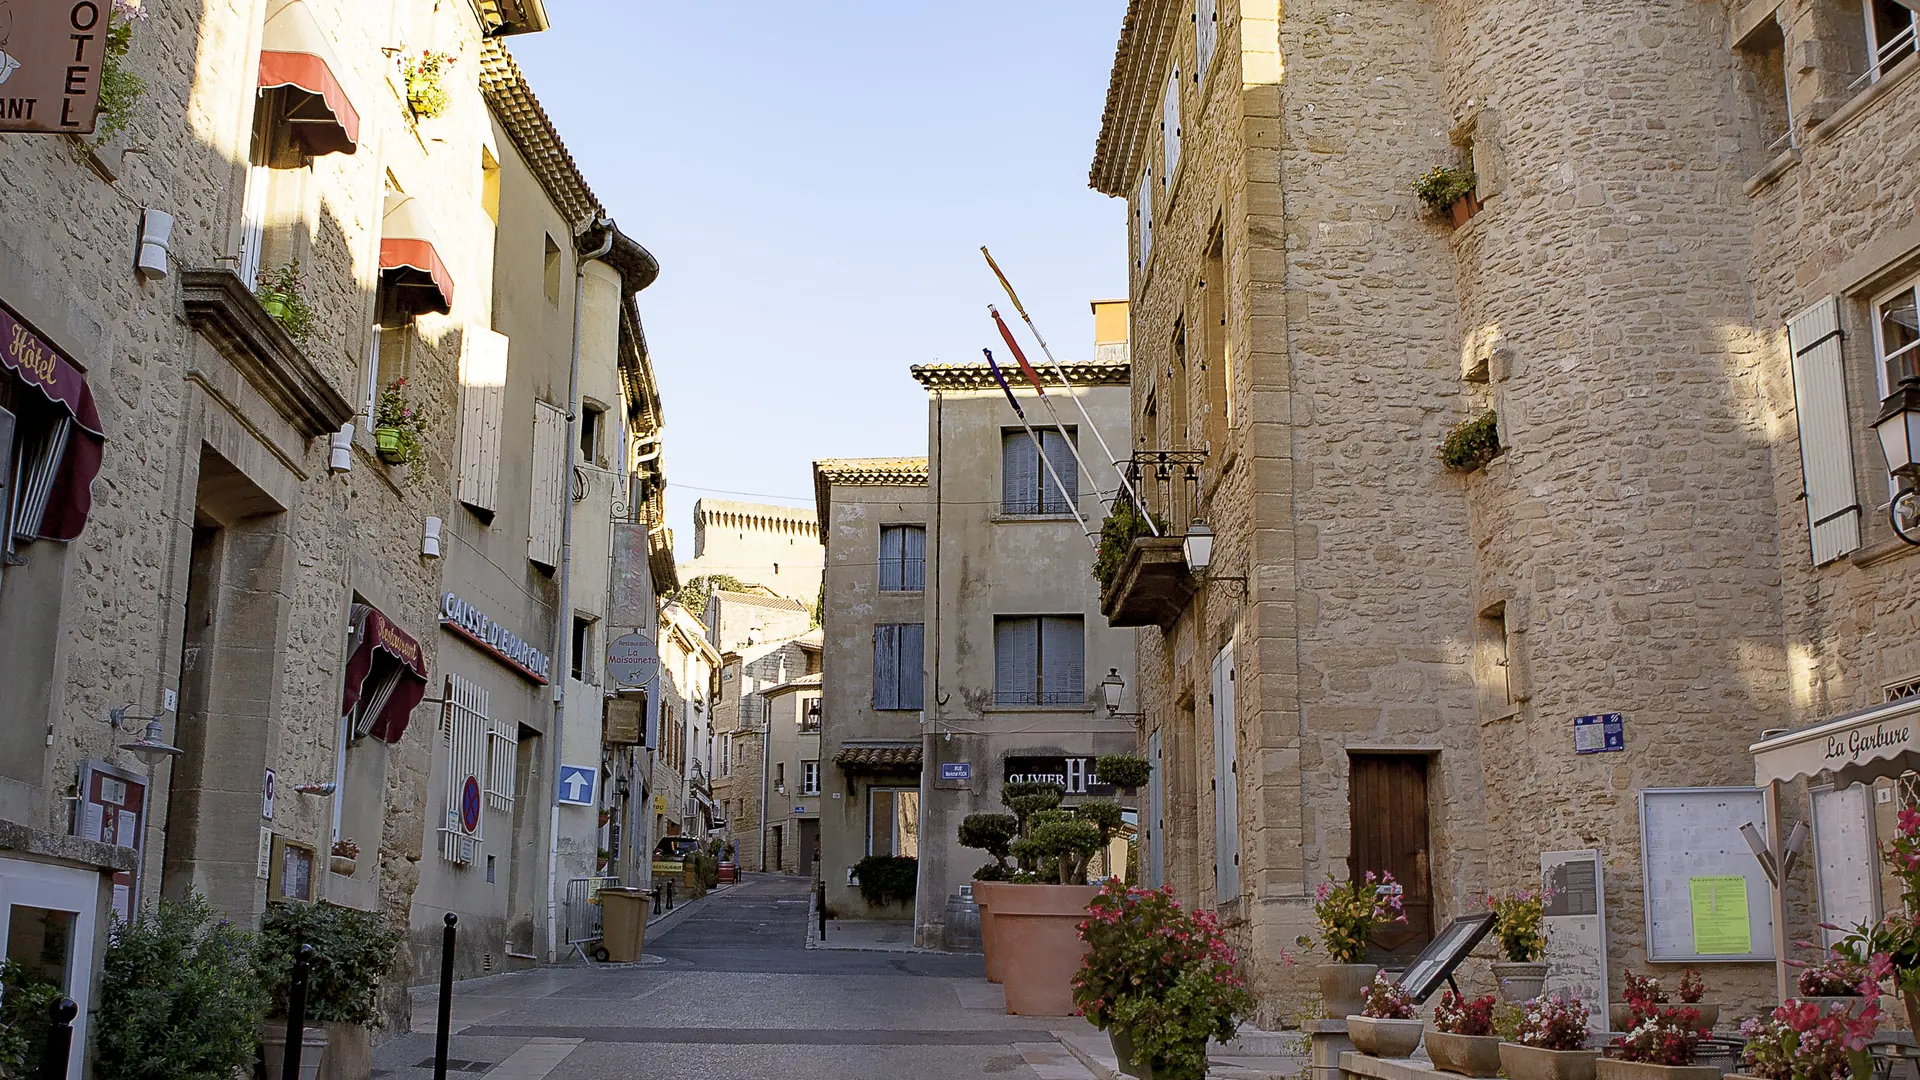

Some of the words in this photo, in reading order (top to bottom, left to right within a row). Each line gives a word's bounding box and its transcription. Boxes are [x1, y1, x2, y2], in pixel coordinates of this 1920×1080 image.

[9, 323, 57, 385] Hôtel
[378, 616, 417, 660] Restaurant
[444, 592, 489, 638] CAISSE
[491, 621, 550, 678] D'EPARGNE
[627, 648, 639, 656] La
[608, 655, 657, 664] Maisouneta
[1825, 735, 1846, 759] La
[1848, 724, 1910, 760] Garbure
[1009, 774, 1065, 785] OLIVIER
